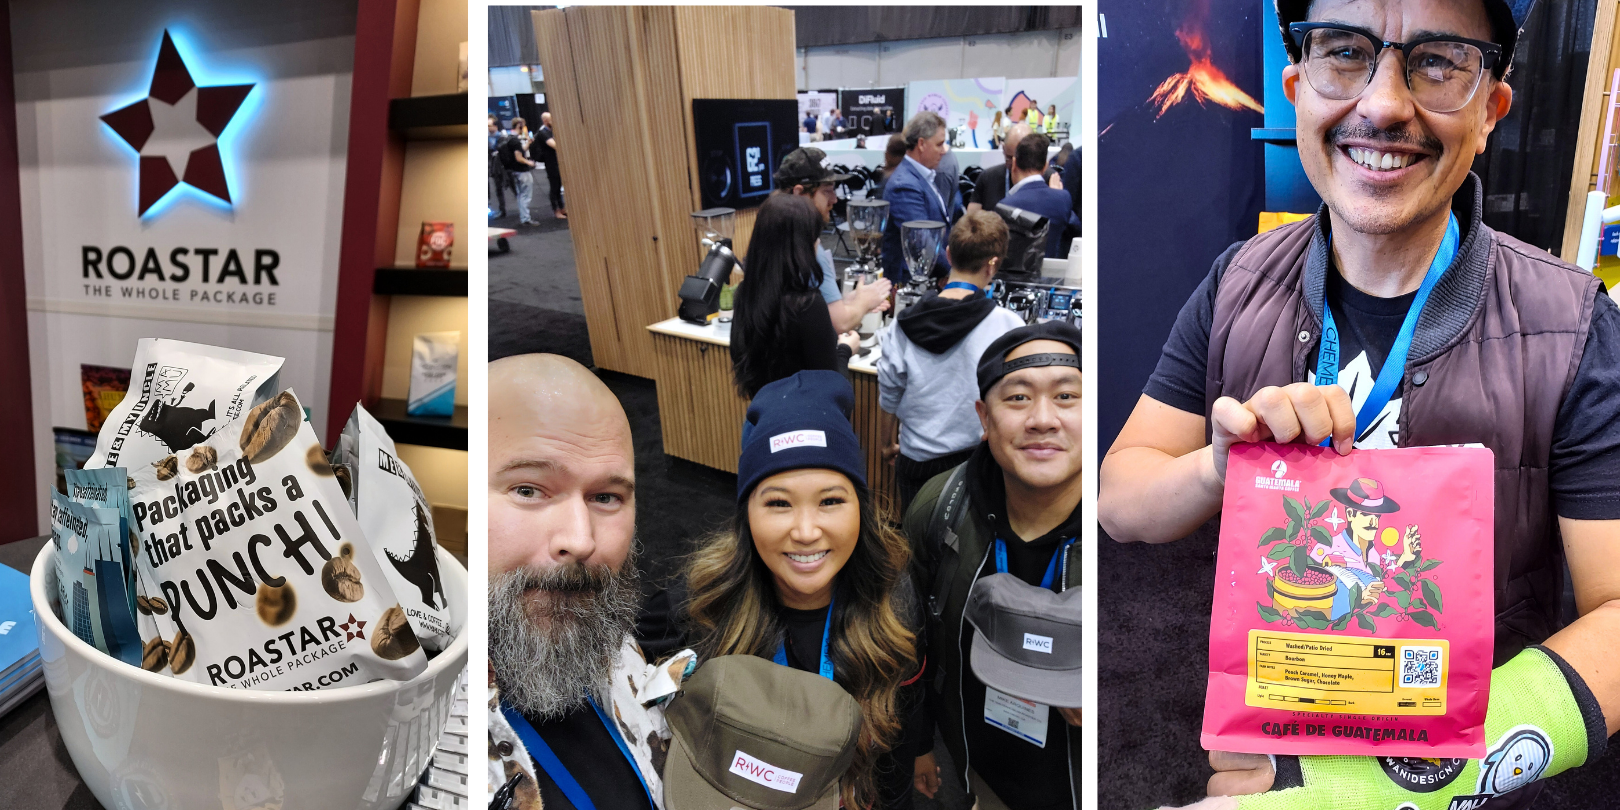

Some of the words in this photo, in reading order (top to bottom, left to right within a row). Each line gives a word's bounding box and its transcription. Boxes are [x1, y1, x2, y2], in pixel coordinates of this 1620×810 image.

[81, 245, 281, 286] ROASTAR
[83, 284, 112, 298] THE
[120, 286, 181, 301] WHOLE
[189, 289, 277, 306] PACKAGE
[117, 412, 141, 437] MY
[131, 361, 159, 412] UNCLE
[378, 447, 397, 476] ME
[1255, 476, 1300, 488] GUATEMALA
[132, 454, 257, 533] Packaging
[144, 522, 194, 569] that
[194, 486, 278, 552] packs
[281, 474, 305, 501] a
[206, 615, 342, 687] ROASTAR
[1285, 655, 1306, 663] Bourbon
[1377, 648, 1386, 656] 16
[240, 665, 284, 689] WHOLE
[287, 640, 347, 671] PACKAGE
[1285, 668, 1299, 677] Peach
[1300, 670, 1320, 679] Caramel,
[1321, 672, 1335, 680] Honey
[1336, 673, 1354, 682] Maple,
[1300, 677, 1316, 686] Sugar,
[1316, 678, 1341, 687] Chocolate
[1292, 711, 1334, 719] SPECIALTY
[1261, 720, 1300, 736] CAFÉ
[1305, 723, 1326, 736] DE
[1331, 725, 1429, 742] GUATEMALA
